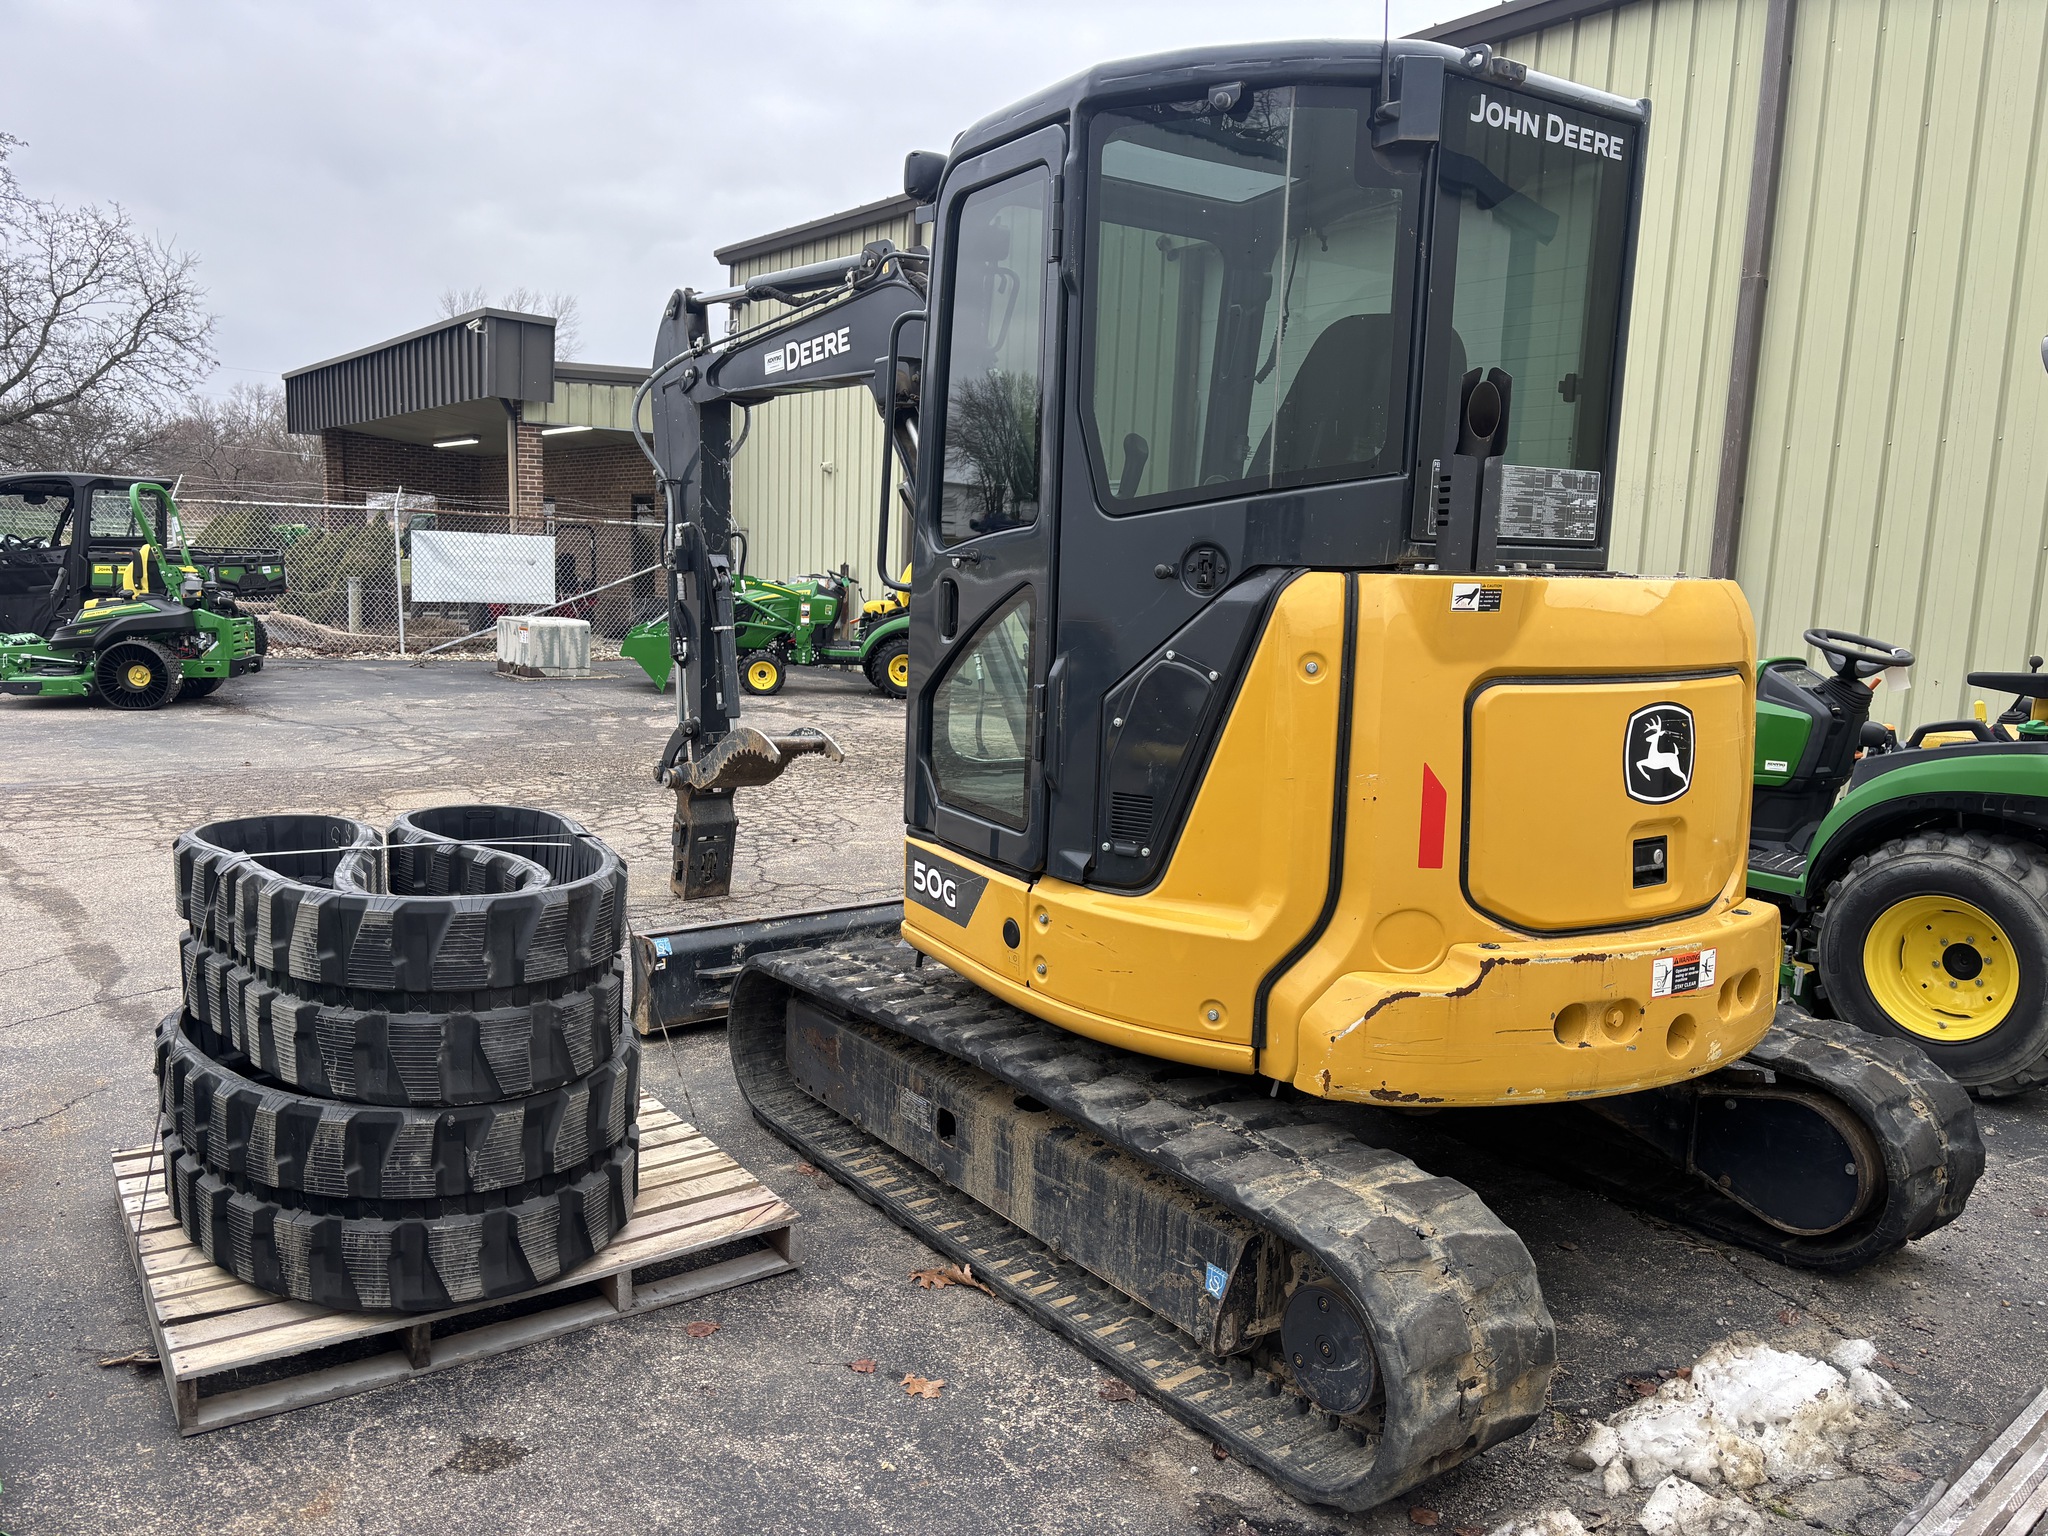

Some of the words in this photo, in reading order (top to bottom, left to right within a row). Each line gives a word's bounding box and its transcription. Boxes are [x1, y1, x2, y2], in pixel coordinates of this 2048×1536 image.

[1470, 93, 1540, 139] JOHN
[1545, 113, 1624, 161] DEERE
[785, 326, 851, 371] DEERE
[913, 860, 956, 908] 50G
[1678, 953, 1700, 963] WARNING
